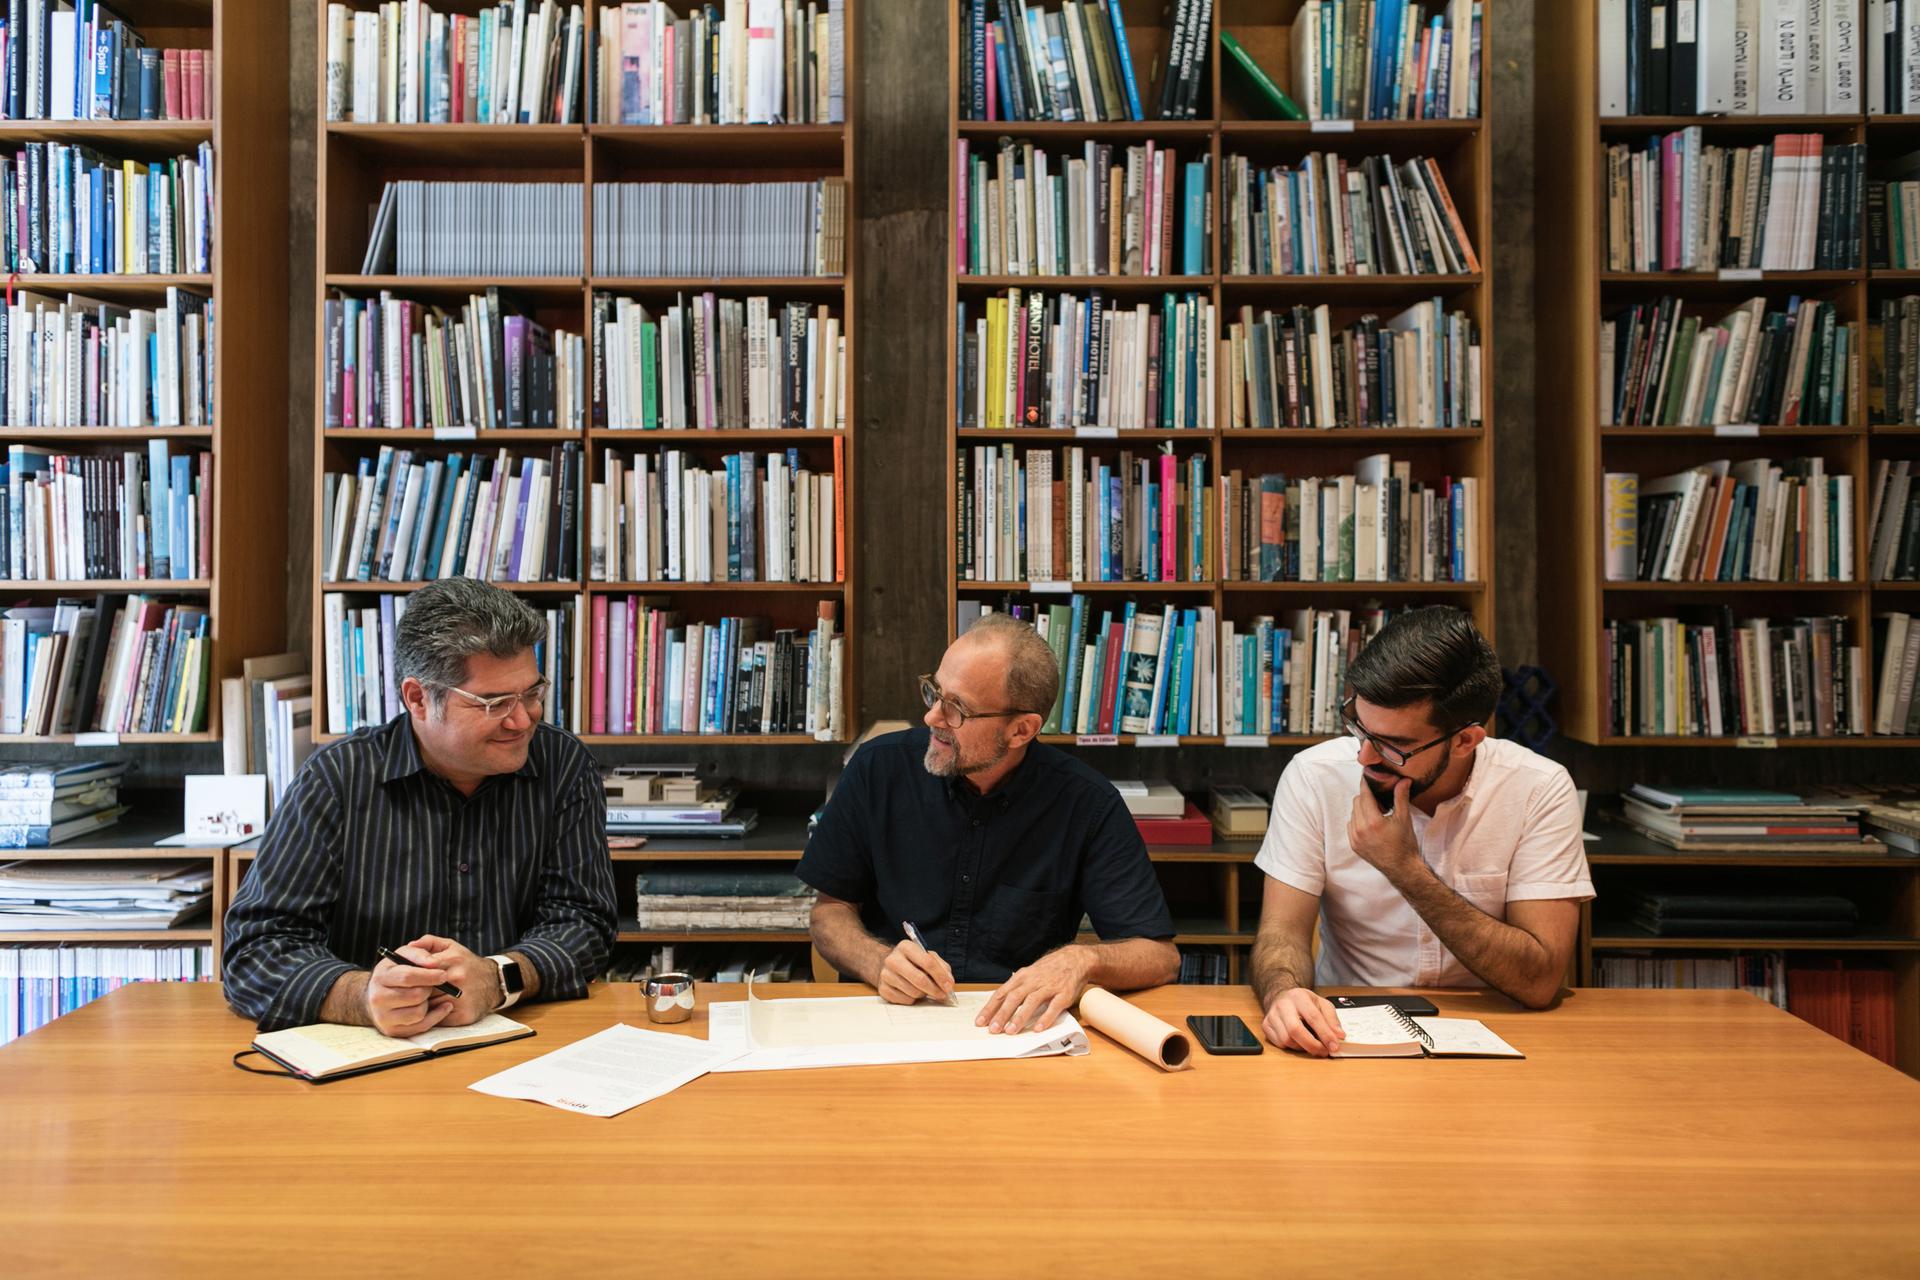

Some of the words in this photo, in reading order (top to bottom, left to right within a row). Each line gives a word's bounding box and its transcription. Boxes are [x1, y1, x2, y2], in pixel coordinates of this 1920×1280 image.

[974, 6, 984, 28] THE
[95, 46, 108, 75] Spain
[974, 30, 984, 68] HOUSE
[1170, 25, 1185, 66] BUILDERS
[1195, 23, 1209, 62] BUILDERS
[974, 70, 984, 82] OF
[1180, 43, 1194, 80] BUILDERS
[1438, 43, 1450, 95] BRIDGES
[974, 85, 984, 110] GOD
[1099, 150, 1108, 181] Corporate
[594, 307, 602, 345] Architects
[1030, 292, 1043, 334] GRAND
[1091, 296, 1102, 339] LUXURY
[511, 336, 520, 388] ARCHITECTURE
[1028, 335, 1040, 372] HOTEL
[1089, 341, 1100, 381] HOTELS
[1199, 318, 1208, 379] MOTELS
[1287, 340, 1295, 351] THE
[511, 390, 520, 411] NOW!
[1002, 448, 1010, 475] Modern
[1905, 650, 1916, 668] CITY
